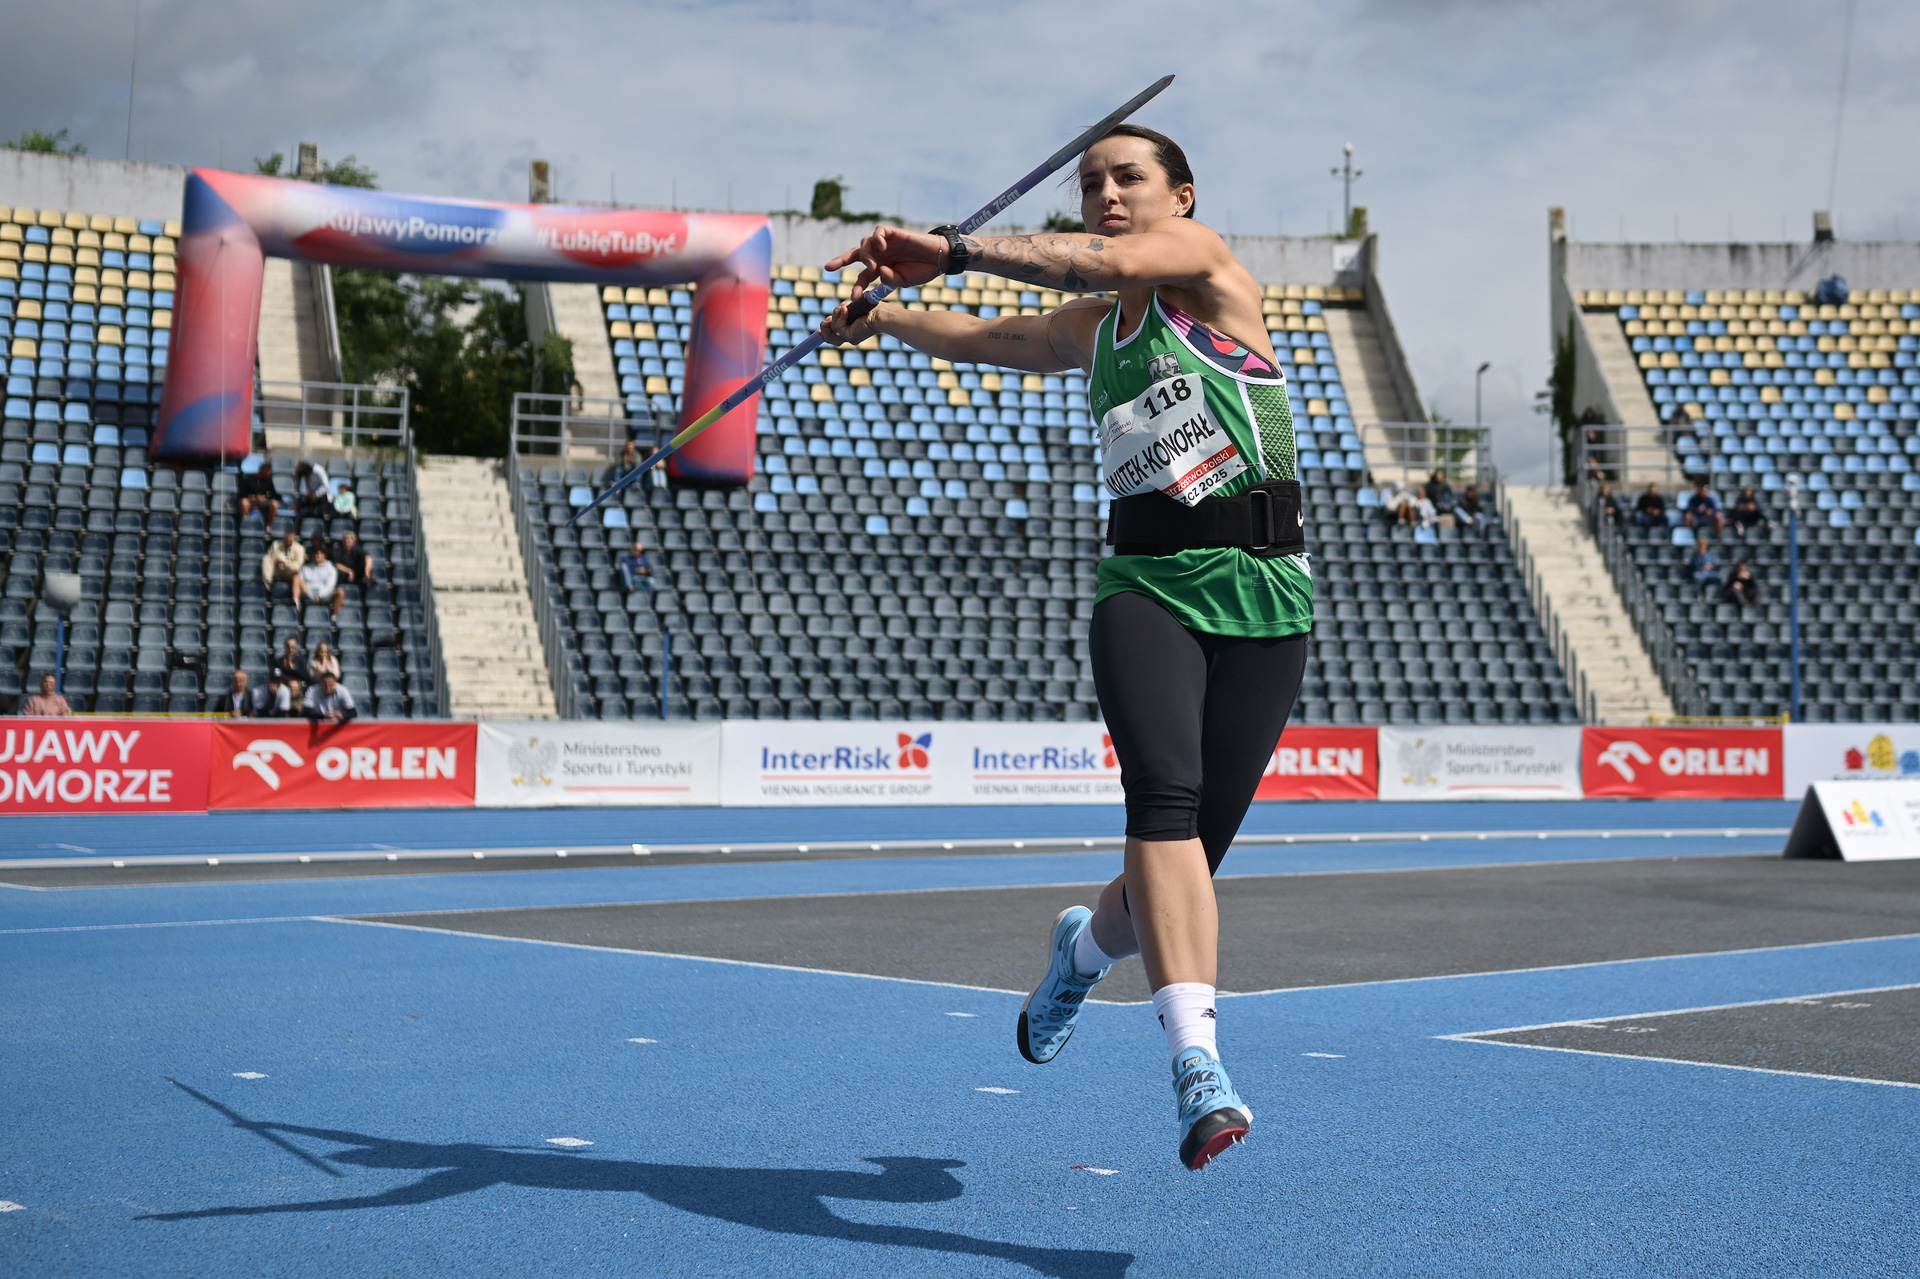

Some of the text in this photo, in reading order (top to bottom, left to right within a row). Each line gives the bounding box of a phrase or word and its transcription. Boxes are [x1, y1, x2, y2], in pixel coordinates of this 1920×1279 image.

[993, 189, 1021, 212] 75m
[536, 227, 676, 257] #LubięTuByć
[1143, 378, 1192, 420] 118
[1106, 413, 1216, 496] WITEK-KONOFAŁ
[1165, 449, 1230, 497] strzostwa Polski
[1180, 468, 1228, 504] ZCZ 2025
[563, 742, 662, 757] Ministerstwo
[762, 746, 891, 770] InterRisk
[973, 747, 1097, 770] InterRisk
[1446, 743, 1535, 757] Ministerstwo
[1659, 747, 1769, 776] ORLEN
[315, 746, 457, 781] ORLEN
[562, 761, 692, 777] Sportu i Turystyki
[1446, 760, 1563, 776] Sportu i Turystyki
[761, 784, 933, 796] VIENNA INSURANCE GROUP
[973, 783, 1123, 795] VIENNA INSURANCE GRO
[1179, 1070, 1217, 1098] NIKE
